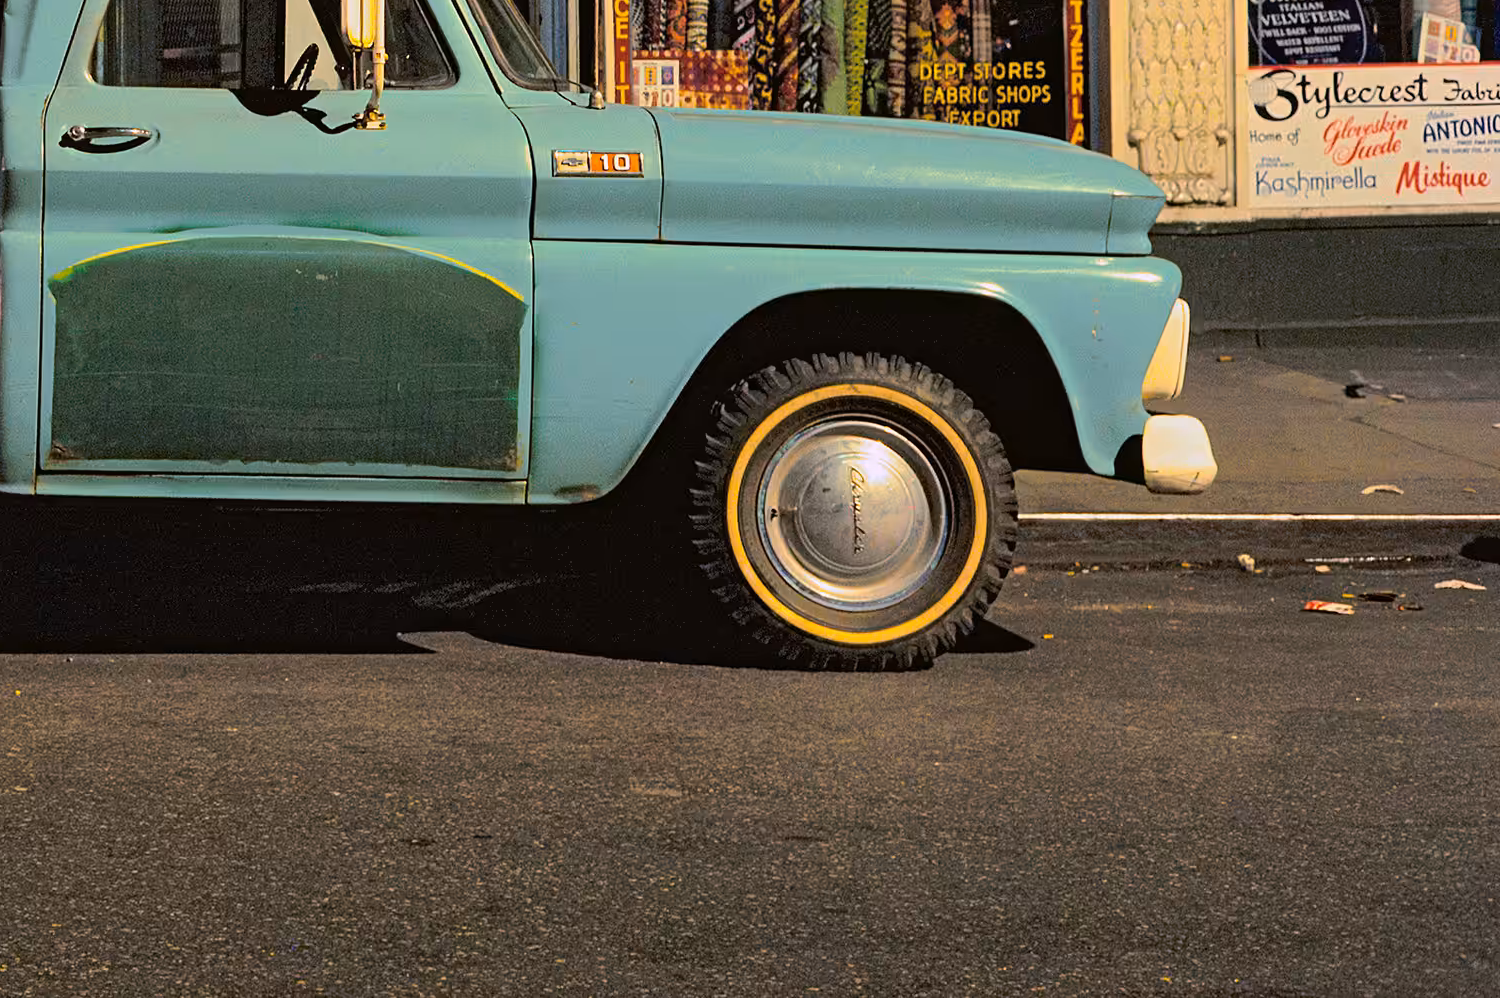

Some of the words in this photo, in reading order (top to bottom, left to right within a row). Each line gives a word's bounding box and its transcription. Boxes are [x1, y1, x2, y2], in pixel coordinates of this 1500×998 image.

[1260, 9, 1351, 27] VELVETEEN
[919, 62, 967, 81] DEPT
[973, 61, 1046, 81] STORES
[923, 85, 989, 105] FABRIC
[996, 84, 1052, 104] SHOPS
[1251, 68, 1429, 122] Stylecrest
[950, 109, 1021, 127] EXPORT
[1250, 130, 1283, 143] Home
[1286, 128, 1301, 146] of
[1323, 110, 1410, 154] Gloveskin
[1332, 131, 1402, 167] Suede
[600, 153, 631, 171] 10
[1255, 166, 1377, 199] Kashmirella
[1395, 160, 1492, 197] Mistique
